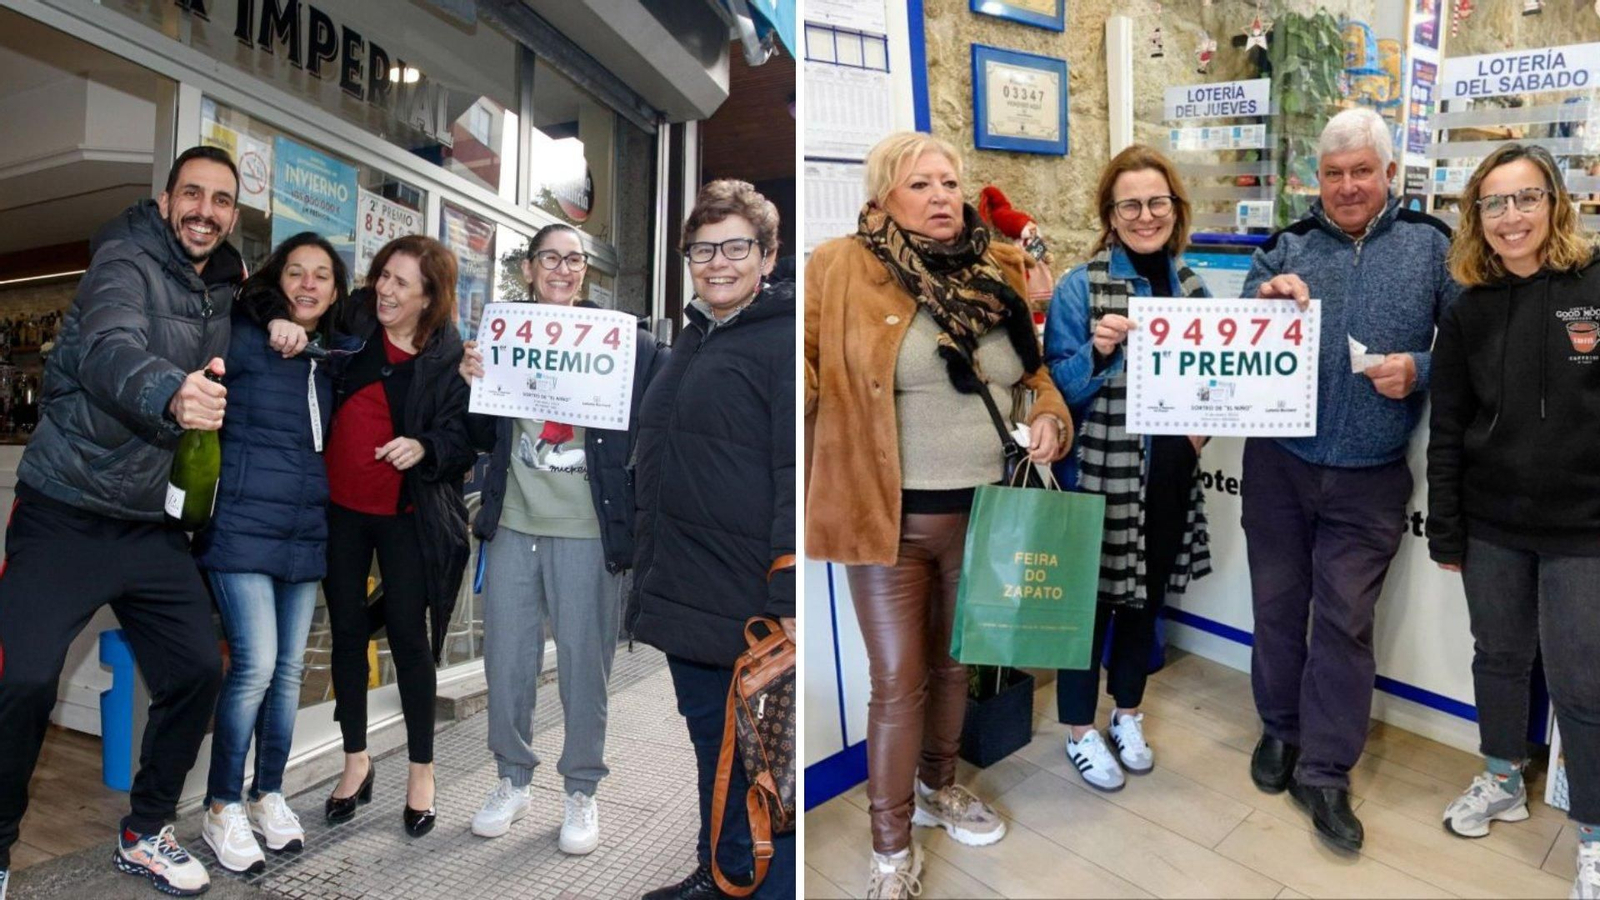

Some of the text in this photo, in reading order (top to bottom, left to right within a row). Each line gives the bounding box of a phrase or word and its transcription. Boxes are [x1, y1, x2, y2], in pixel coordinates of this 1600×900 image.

[234, 0, 453, 148] IMPERIAL
[1478, 48, 1566, 77] LOTERÍA
[1003, 85, 1044, 101] 03347
[1187, 82, 1246, 103] LOTERÍA
[1455, 78, 1493, 97] DEL
[1498, 69, 1589, 93] SABADO
[1176, 100, 1257, 118] DEL JUEVES
[285, 163, 349, 203] INVIERNO
[382, 204, 413, 227] PREMIO
[1555, 310, 1581, 318] GOOD
[490, 317, 621, 350] 94974
[1150, 317, 1303, 347] 94974
[512, 347, 615, 376] PREMIO
[1179, 350, 1298, 377] PREMIO
[1013, 551, 1058, 567] FEIRA
[1024, 569, 1047, 582] DO
[1003, 584, 1063, 600] ZAPATO
